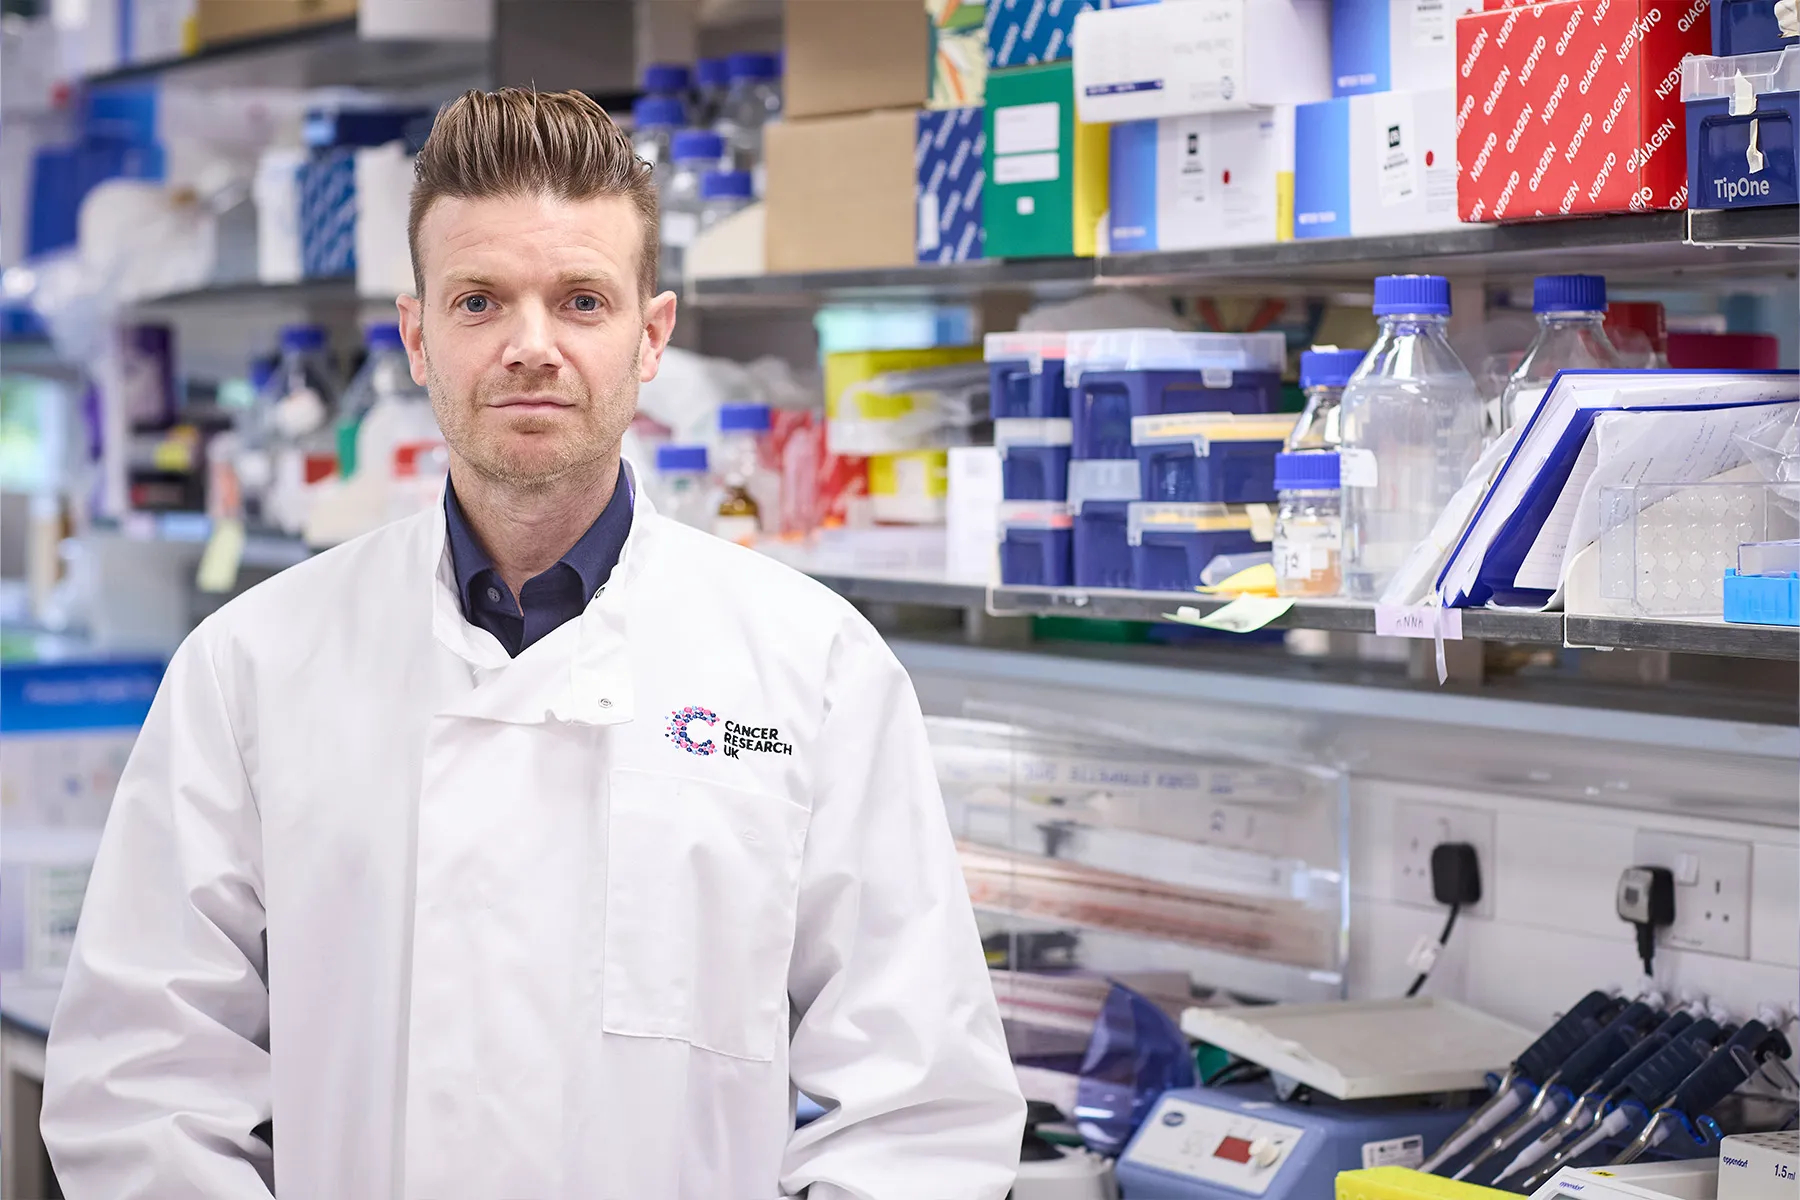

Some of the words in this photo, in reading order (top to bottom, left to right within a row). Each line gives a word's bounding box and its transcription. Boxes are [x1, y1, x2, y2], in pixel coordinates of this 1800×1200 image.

[1461, 27, 1489, 78] QIAGEN
[1555, 5, 1584, 56] QIAGEN
[1518, 35, 1547, 87] QIAGEN
[1578, 43, 1608, 95] QIAGEN
[1483, 64, 1511, 116] QIAGEN
[1541, 73, 1570, 126] QIAGEN
[1602, 82, 1632, 134] QIAGEN
[1505, 102, 1533, 153] QIAGEN
[1565, 112, 1593, 164] QIAGEN
[1470, 132, 1498, 183] QIAGEN
[1528, 141, 1557, 193] QIAGEN
[1588, 152, 1617, 204] QIAGEN
[1493, 170, 1520, 219] QIAGEN
[1713, 177, 1770, 203] TipOne
[723, 745, 740, 760] UK
[724, 720, 779, 740] CANCER
[724, 732, 793, 755] RESEARCH
